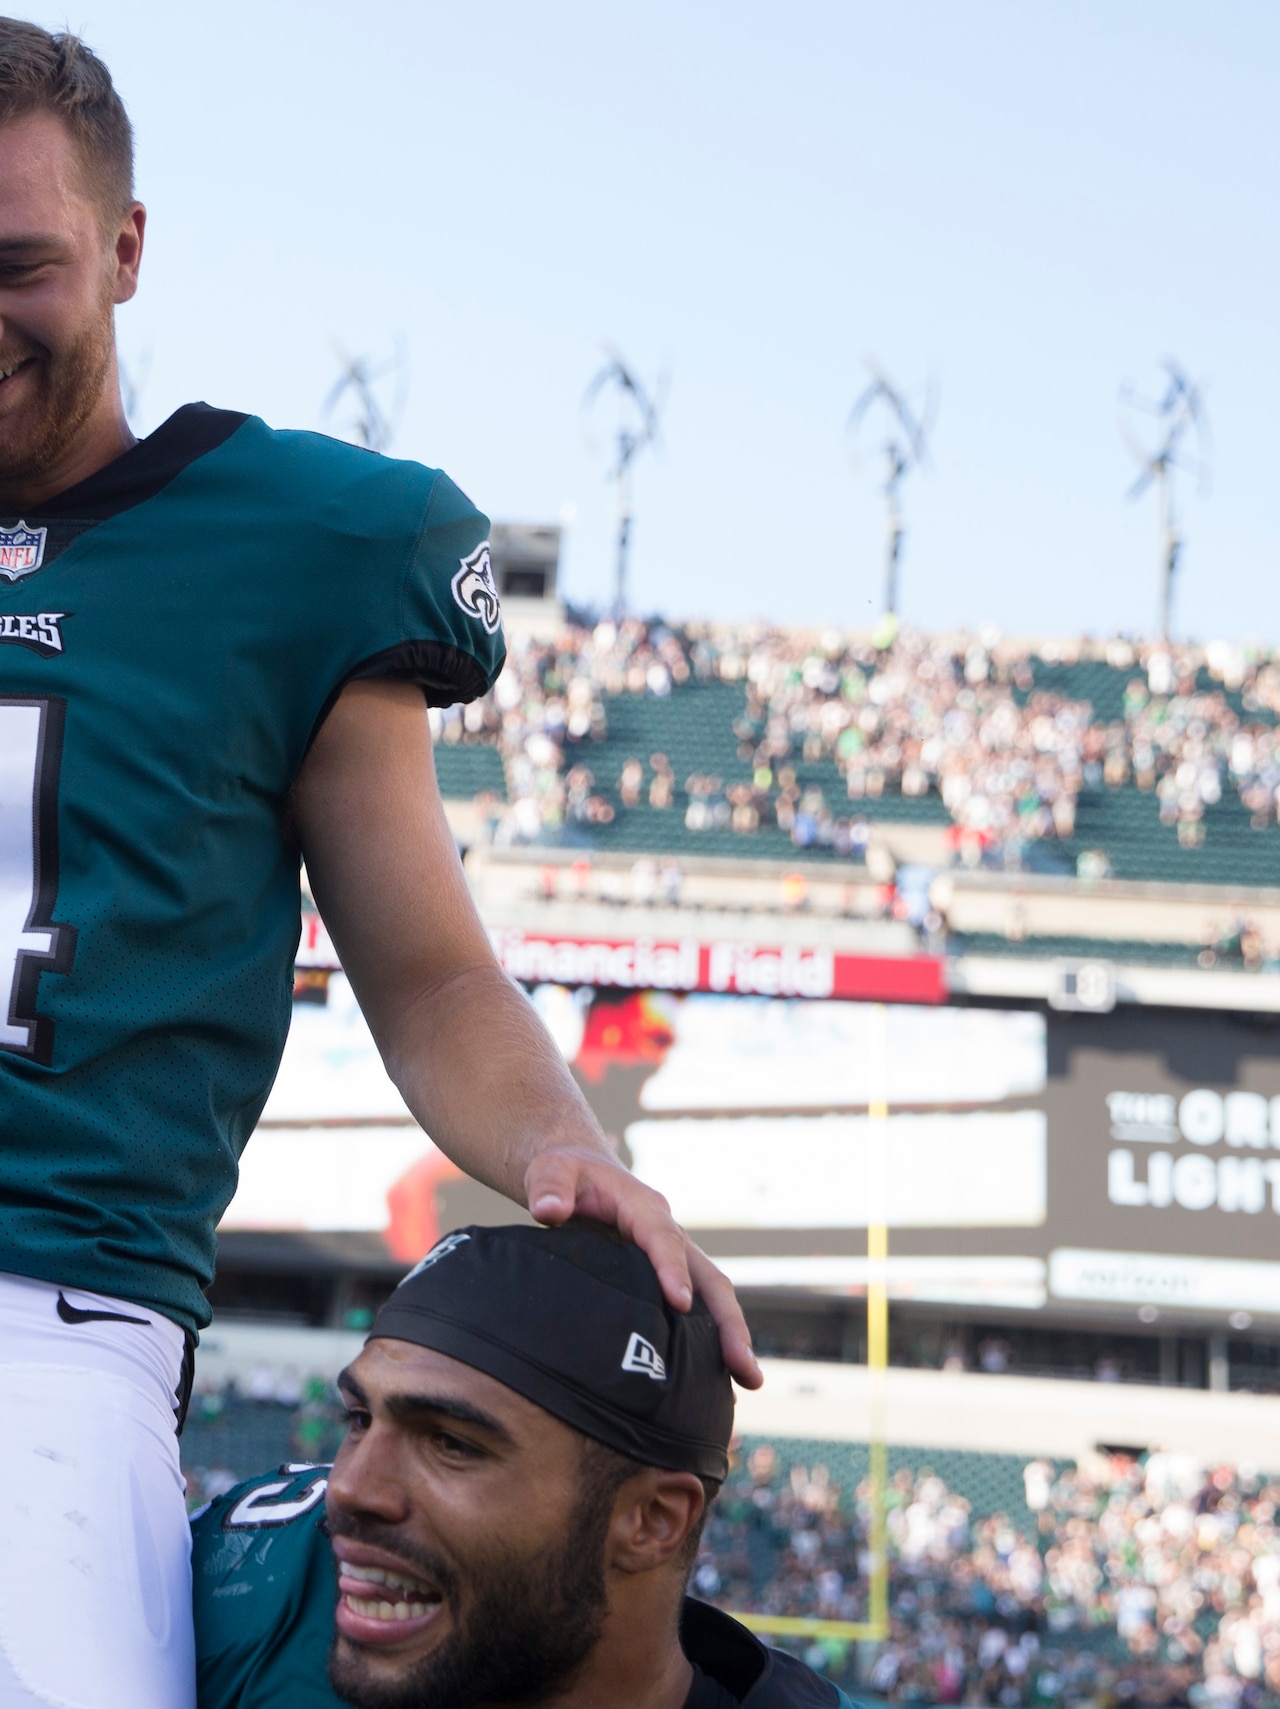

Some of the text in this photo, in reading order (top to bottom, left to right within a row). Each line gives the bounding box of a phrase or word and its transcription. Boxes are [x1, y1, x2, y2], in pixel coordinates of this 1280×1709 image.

[0, 547, 34, 569] NFL
[708, 942, 834, 999] Field
[1106, 1089, 1280, 1150] THE OR
